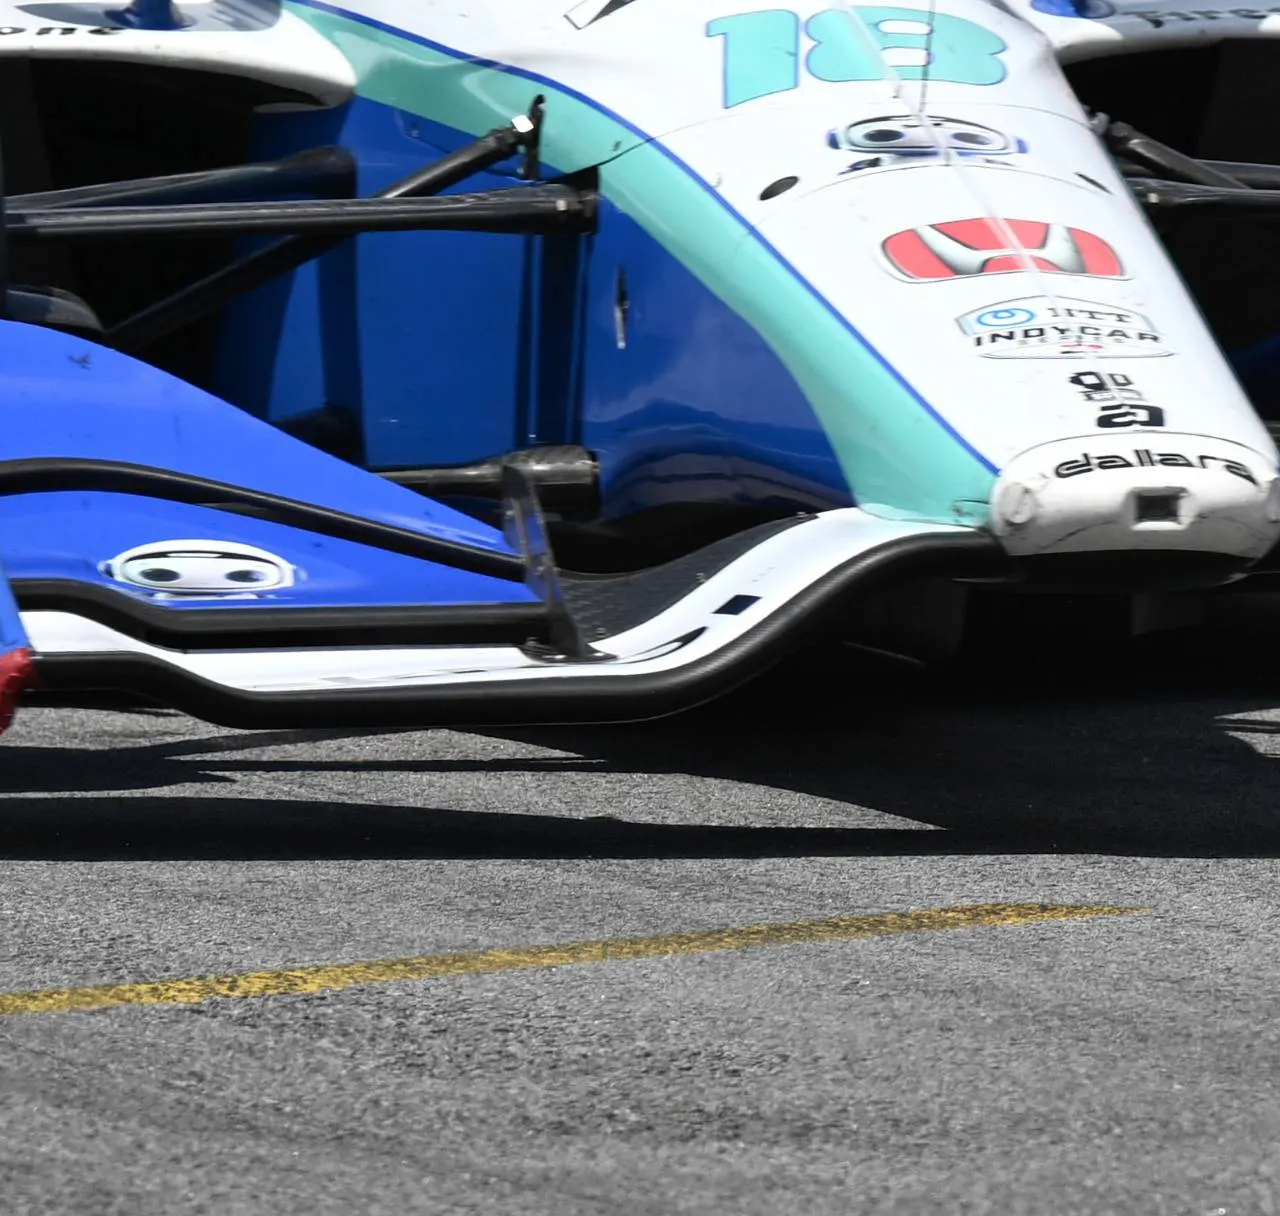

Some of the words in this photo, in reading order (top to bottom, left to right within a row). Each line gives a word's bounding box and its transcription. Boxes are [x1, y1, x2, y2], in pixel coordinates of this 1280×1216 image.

[705, 4, 1007, 110] 18
[975, 326, 1160, 346] INDYCAR
[1054, 448, 1260, 486] dallara
